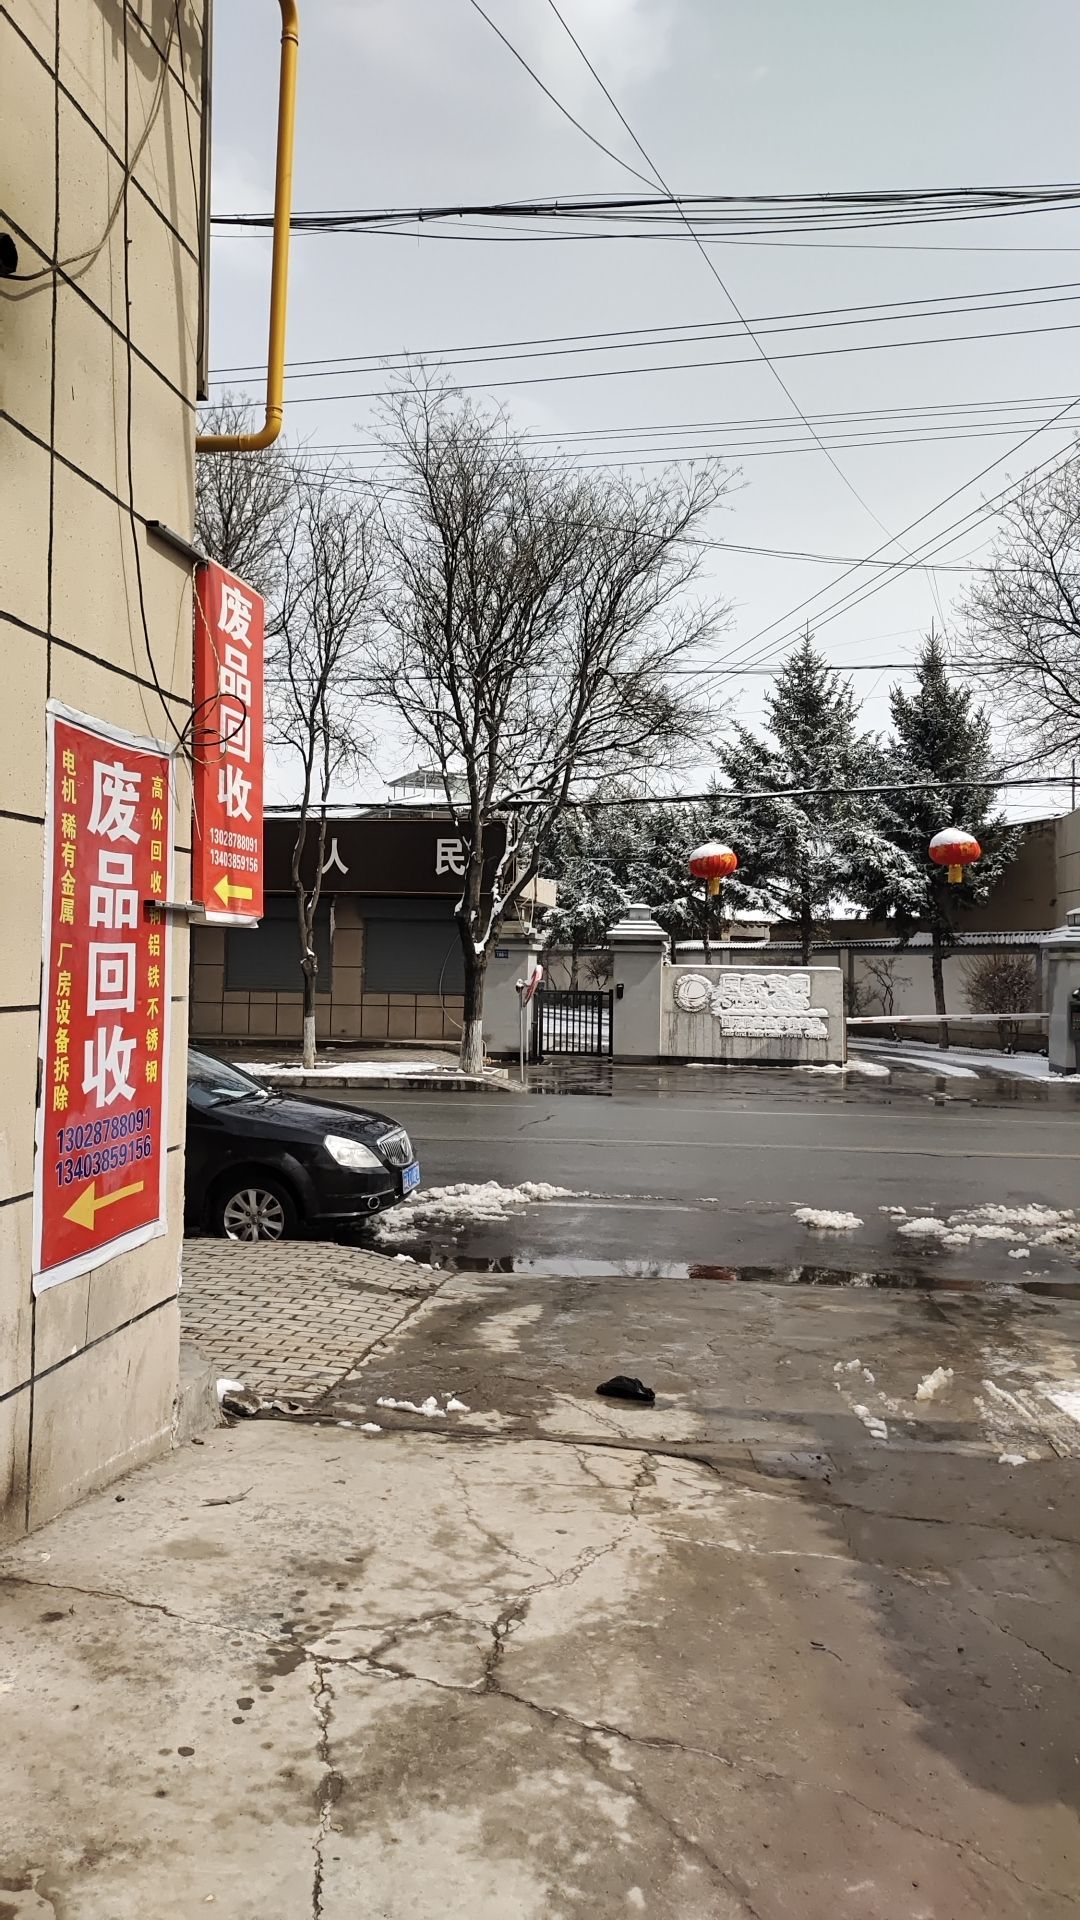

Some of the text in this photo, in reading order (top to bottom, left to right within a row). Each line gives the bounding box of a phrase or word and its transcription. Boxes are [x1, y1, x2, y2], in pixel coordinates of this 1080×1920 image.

[217, 580, 253, 822] 废品回收
[210, 827, 258, 853] 13028788091
[210, 849, 258, 873] 13403859156
[53, 748, 77, 1111] 电机 稀有金属 厂房设备拆除
[82, 759, 142, 1108] 废品回收
[56, 1106, 152, 1154] 13028788091
[55, 1134, 152, 1187] 13403859156
